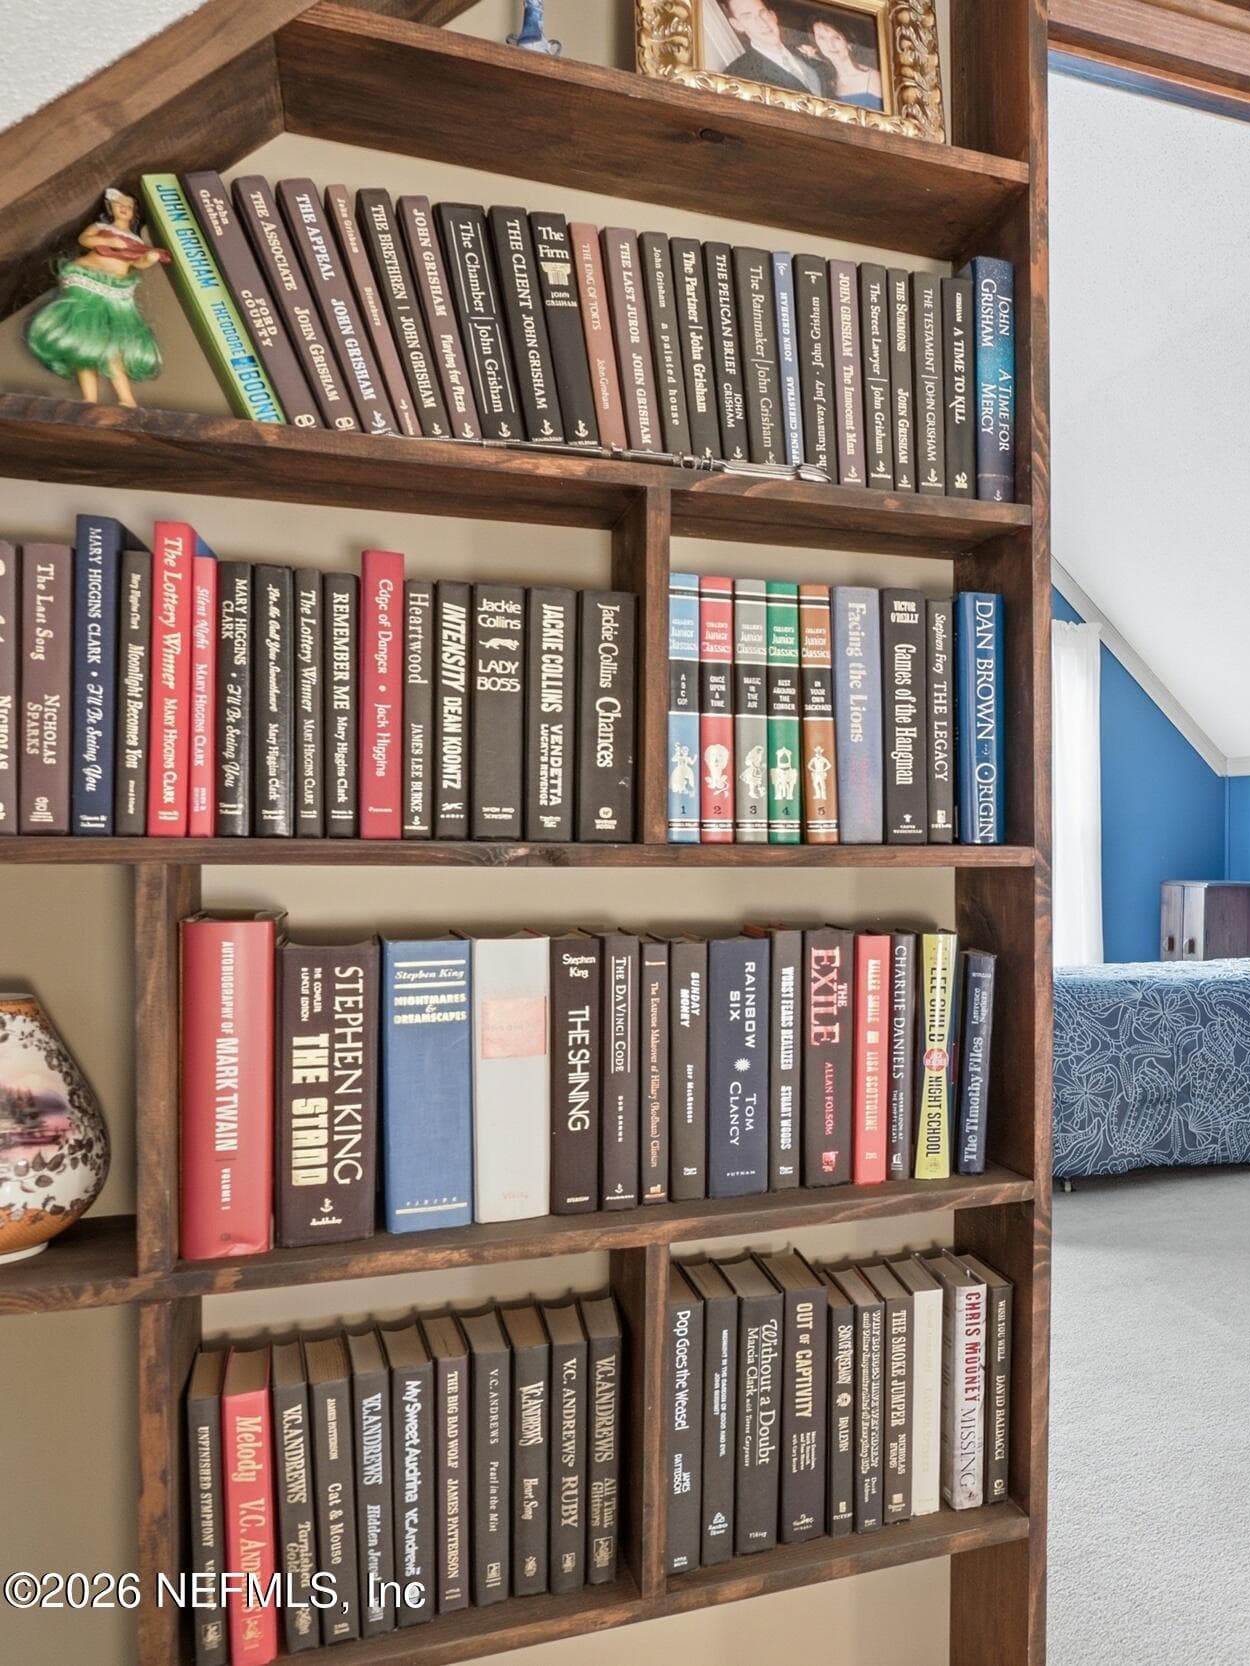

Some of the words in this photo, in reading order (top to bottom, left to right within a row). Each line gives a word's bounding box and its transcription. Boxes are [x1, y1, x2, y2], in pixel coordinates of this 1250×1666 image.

[156, 185, 183, 222] JOHN
[176, 227, 220, 289] GRISHAM
[250, 191, 269, 217] THE
[261, 219, 298, 291] ASSOCIATE
[459, 222, 474, 248] The
[505, 219, 523, 251] THE
[538, 226, 564, 241] The
[539, 245, 569, 259] Firm
[460, 251, 483, 313] Chamber
[511, 254, 532, 309] CLIENT
[520, 314, 536, 346] JOHN
[954, 328, 964, 336] A
[981, 279, 997, 347] GRISHAM
[997, 295, 1012, 335] JOHN
[294, 306, 316, 340] JOHN
[309, 344, 340, 401] GRISHAM
[474, 323, 491, 354] John
[953, 341, 965, 372] TIME
[211, 301, 246, 356] THEODORE
[240, 363, 281, 424] BOONE
[525, 348, 547, 409] GRISHAM
[999, 369, 1012, 381] A
[478, 357, 503, 413] Grisham
[954, 374, 965, 392] TO
[949, 394, 966, 424] KILL
[981, 383, 993, 435] MERCY
[999, 387, 1012, 420] TIME
[999, 422, 1010, 451] FOR
[89, 527, 102, 567] MARY
[164, 537, 182, 570] The
[36, 563, 54, 588] The
[36, 592, 54, 626] Last
[88, 569, 102, 626] HIGGINS
[159, 572, 182, 628] Lottery
[477, 599, 521, 614] Jackie
[332, 592, 349, 681] REMEMBER
[408, 592, 429, 684] Heartwood
[478, 614, 521, 630] Collins
[542, 604, 564, 651] JACKIE
[597, 603, 620, 641] Jackie
[772, 634, 795, 644] Junior
[845, 602, 866, 657] Facing
[976, 601, 994, 650] DAN
[31, 629, 53, 661] Song
[87, 629, 101, 663] CLARK
[159, 631, 181, 689] Winner
[442, 603, 466, 693] INTENSITY
[769, 646, 798, 657] Classics
[477, 659, 519, 673] LADY
[477, 677, 520, 692] BOSS
[541, 654, 564, 712] COLLINS
[598, 643, 618, 689] Collins
[849, 662, 867, 689] the
[333, 685, 349, 710] ME
[443, 697, 462, 732] DEAN
[934, 681, 947, 714] THE
[976, 658, 994, 741] BROWN
[26, 702, 42, 754] SPARKS
[43, 695, 59, 764] NICHOLAS
[86, 709, 102, 726] Be
[595, 696, 621, 768] Chances
[849, 692, 868, 743] Lions
[442, 735, 462, 789] KOONTZ
[549, 724, 563, 806] VENDETTA
[934, 721, 947, 782] LEGACY
[83, 764, 102, 792] You
[681, 806, 686, 814] 1
[714, 806, 722, 815] 2
[750, 805, 757, 814] 3
[782, 806, 790, 816] 4
[818, 807, 826, 816] 5
[975, 762, 996, 838] ORIGIN
[395, 969, 437, 980] Stephen
[440, 968, 465, 980] King
[562, 954, 596, 966] Stephen
[570, 967, 589, 978] King
[615, 957, 626, 980] THE
[895, 945, 907, 1011] CHARLIE
[220, 941, 235, 1019] AUTOBIOGRAPHY
[615, 984, 626, 1001] DA
[811, 947, 841, 1046] EXILE
[837, 982, 848, 1007] THE
[393, 1011, 467, 1024] DREAMSCAPES
[394, 993, 466, 1007] NIGHTMARES
[425, 1004, 436, 1014] &
[729, 990, 740, 1021] SIX
[745, 961, 756, 1048] RAINBOW
[221, 1021, 234, 1034] OF
[335, 966, 364, 1095] STEPHEN
[568, 1006, 590, 1046] THE
[615, 1004, 626, 1036] VINCI
[216, 1038, 239, 1091] MARK
[292, 1033, 329, 1085] THE
[615, 1040, 626, 1072] CODE
[892, 1016, 905, 1079] DANIELS
[968, 1036, 984, 1071] Files
[568, 1050, 590, 1131] SHINING
[928, 1075, 942, 1109] NIGHT
[966, 1074, 984, 1131] Timothy
[215, 1094, 238, 1152] TWAIN
[729, 1081, 742, 1146] CLANCY
[745, 1093, 757, 1132] TOM
[292, 1097, 328, 1186] STAND
[333, 1105, 364, 1185] KING
[926, 1111, 942, 1158] SCHOOL
[964, 1133, 977, 1162] The
[673, 1310, 691, 1337] Pop
[796, 1303, 813, 1329] OUT
[965, 1292, 981, 1337] CHRIS
[675, 1338, 690, 1369] Goes
[759, 1319, 778, 1392] Without
[799, 1334, 810, 1345] OF
[402, 1380, 422, 1402] My
[675, 1369, 691, 1391] the
[795, 1349, 813, 1418] CAPTIVITY
[996, 1375, 1006, 1408] DAVID
[675, 1389, 690, 1431] Weasel
[760, 1396, 771, 1406] a
[405, 1403, 422, 1446] Sweet
[759, 1409, 776, 1465] Doubt
[995, 1409, 1005, 1461] BALDACCI
[232, 1416, 263, 1482] Melody
[960, 1408, 976, 1488] MISSING
[405, 1446, 422, 1503] Audrina
[561, 1475, 578, 1528] RUBY
